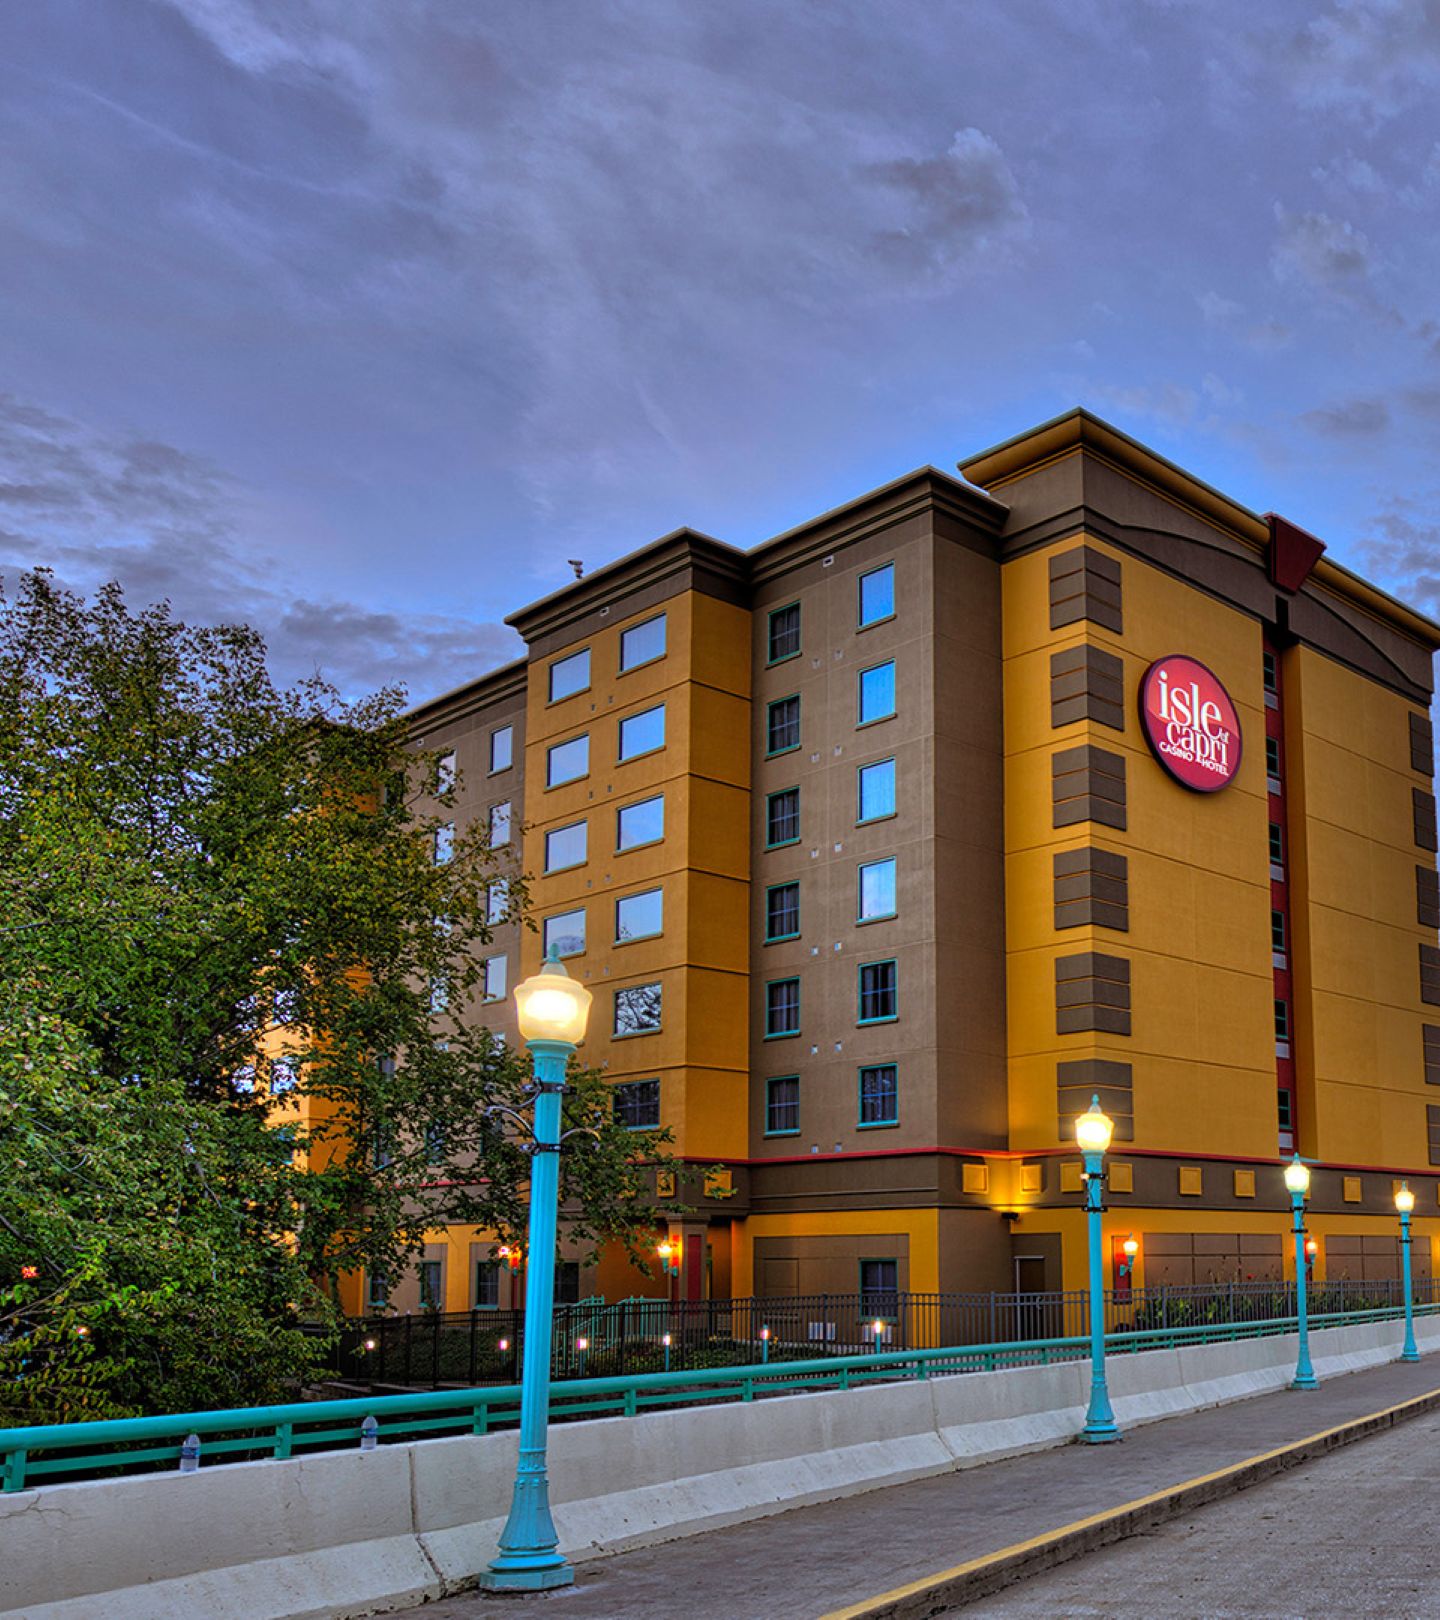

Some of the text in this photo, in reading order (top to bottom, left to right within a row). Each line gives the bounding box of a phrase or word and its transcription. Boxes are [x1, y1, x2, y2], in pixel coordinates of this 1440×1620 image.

[1157, 670, 1222, 739] isle
[1159, 741, 1230, 777] CASINO HOTEL
[1166, 722, 1228, 765] capri
